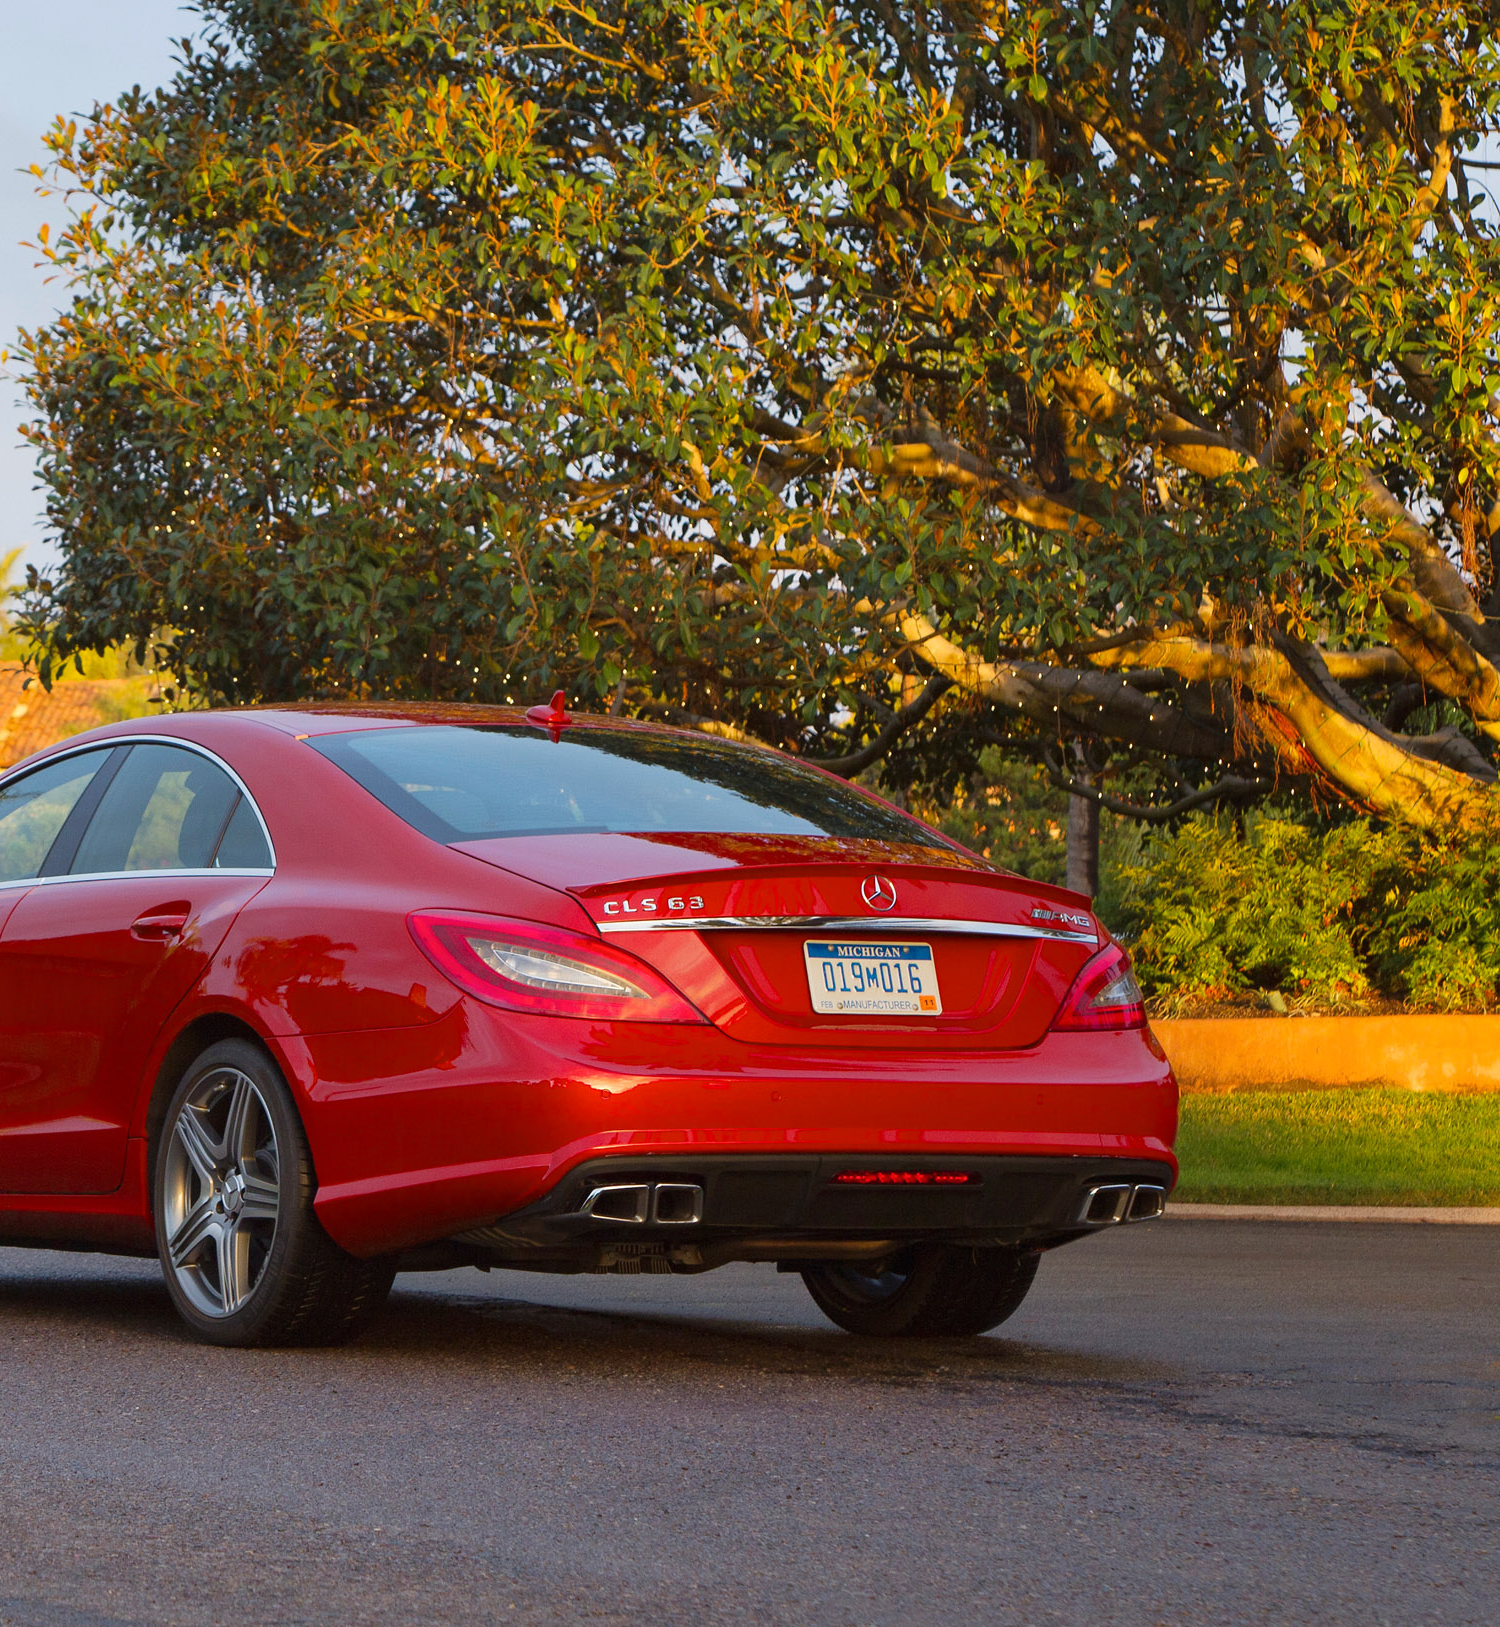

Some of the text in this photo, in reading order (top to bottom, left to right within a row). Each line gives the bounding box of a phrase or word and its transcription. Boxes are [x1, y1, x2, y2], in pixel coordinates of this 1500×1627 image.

[603, 896, 704, 914] CLS 63
[838, 946, 900, 958] MICHIGAN
[822, 962, 922, 993] 019M016
[821, 1001, 833, 1009] FEB
[843, 1000, 911, 1010] MANUFACTURER
